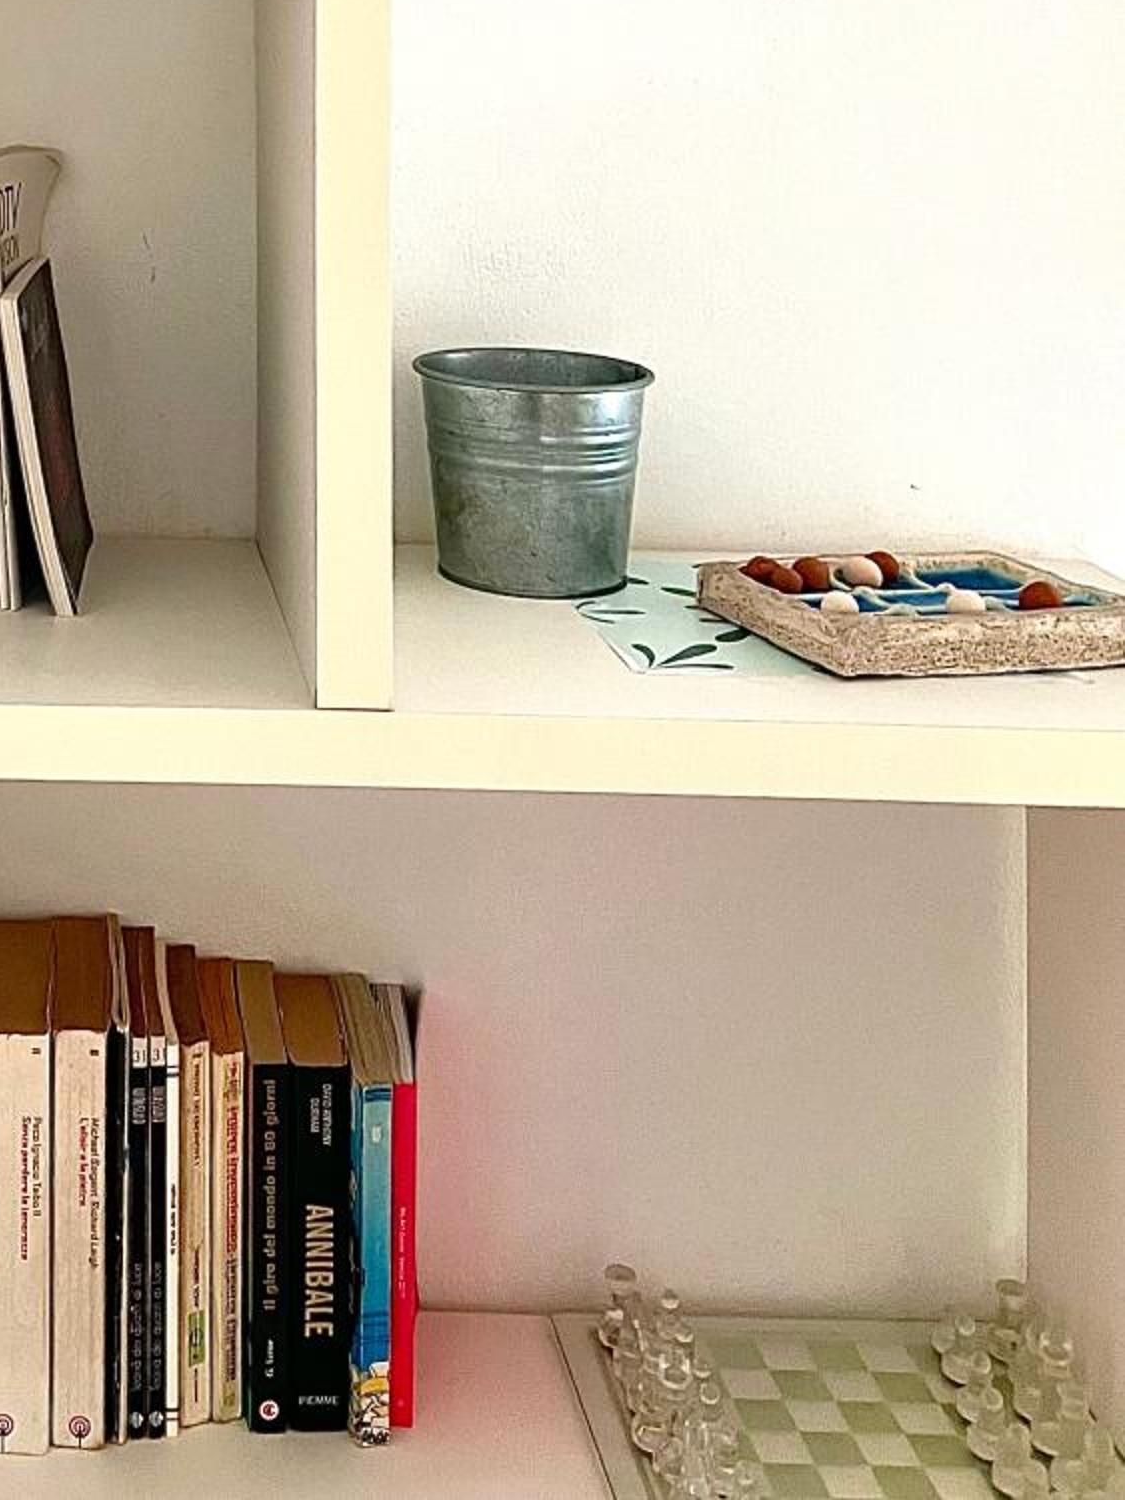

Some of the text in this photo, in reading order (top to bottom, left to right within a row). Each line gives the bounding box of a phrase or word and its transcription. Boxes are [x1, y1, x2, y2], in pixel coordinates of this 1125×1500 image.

[264, 1079, 279, 1126] giorni
[21, 1116, 31, 1148] Senza
[91, 1117, 100, 1157] Michael
[21, 1149, 30, 1194] perdere
[264, 1155, 275, 1171] in
[90, 1200, 99, 1241] Richard
[264, 1175, 276, 1229] mondo
[263, 1234, 275, 1257] del
[304, 1204, 334, 1337] ANNIBALE
